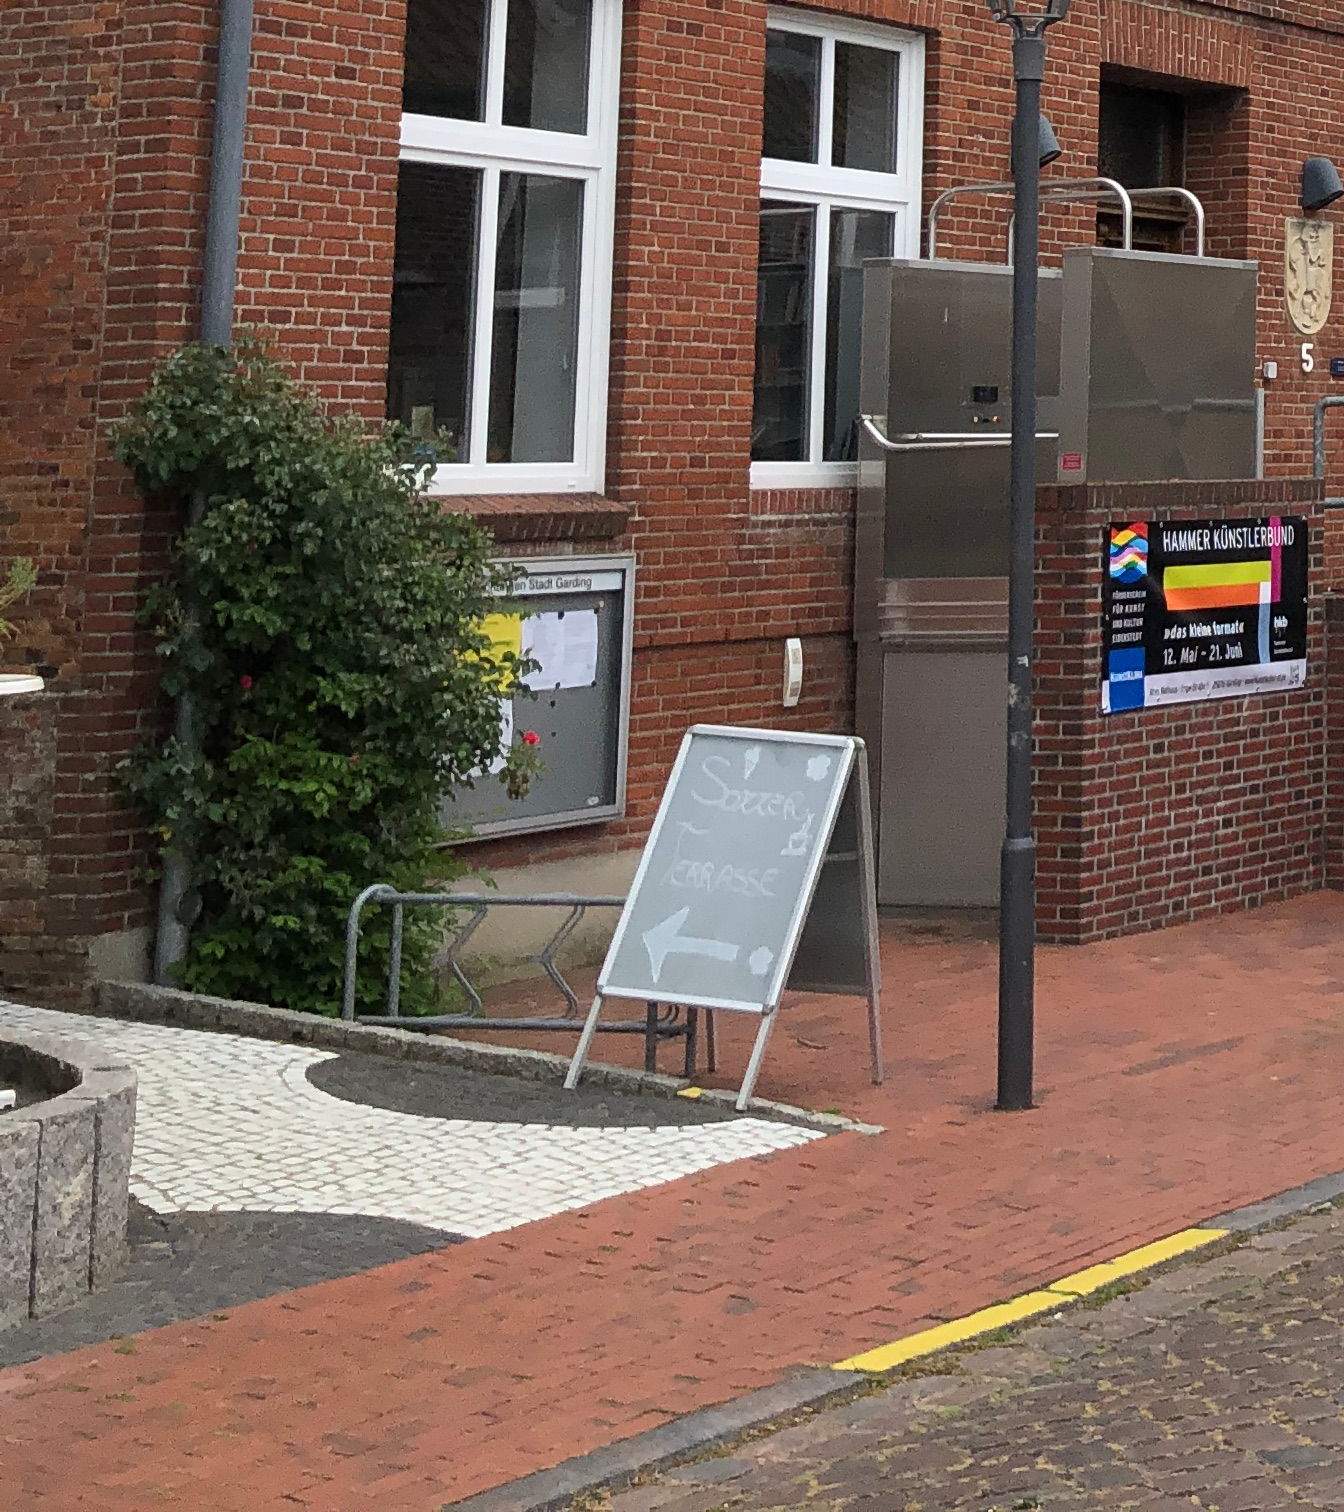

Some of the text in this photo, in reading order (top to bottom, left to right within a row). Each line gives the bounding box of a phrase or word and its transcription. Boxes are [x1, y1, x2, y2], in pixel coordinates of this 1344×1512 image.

[1301, 342, 1314, 373] 5
[1163, 524, 1295, 552] HAMMER KÜNSTLERBUND
[528, 576, 553, 590] Stadt
[555, 576, 592, 591] Garding
[1189, 622, 1212, 638] kleine
[1163, 648, 1177, 666] 12.
[1180, 646, 1199, 664] Mai
[1209, 644, 1222, 661] 21.
[1225, 641, 1243, 659] Juni
